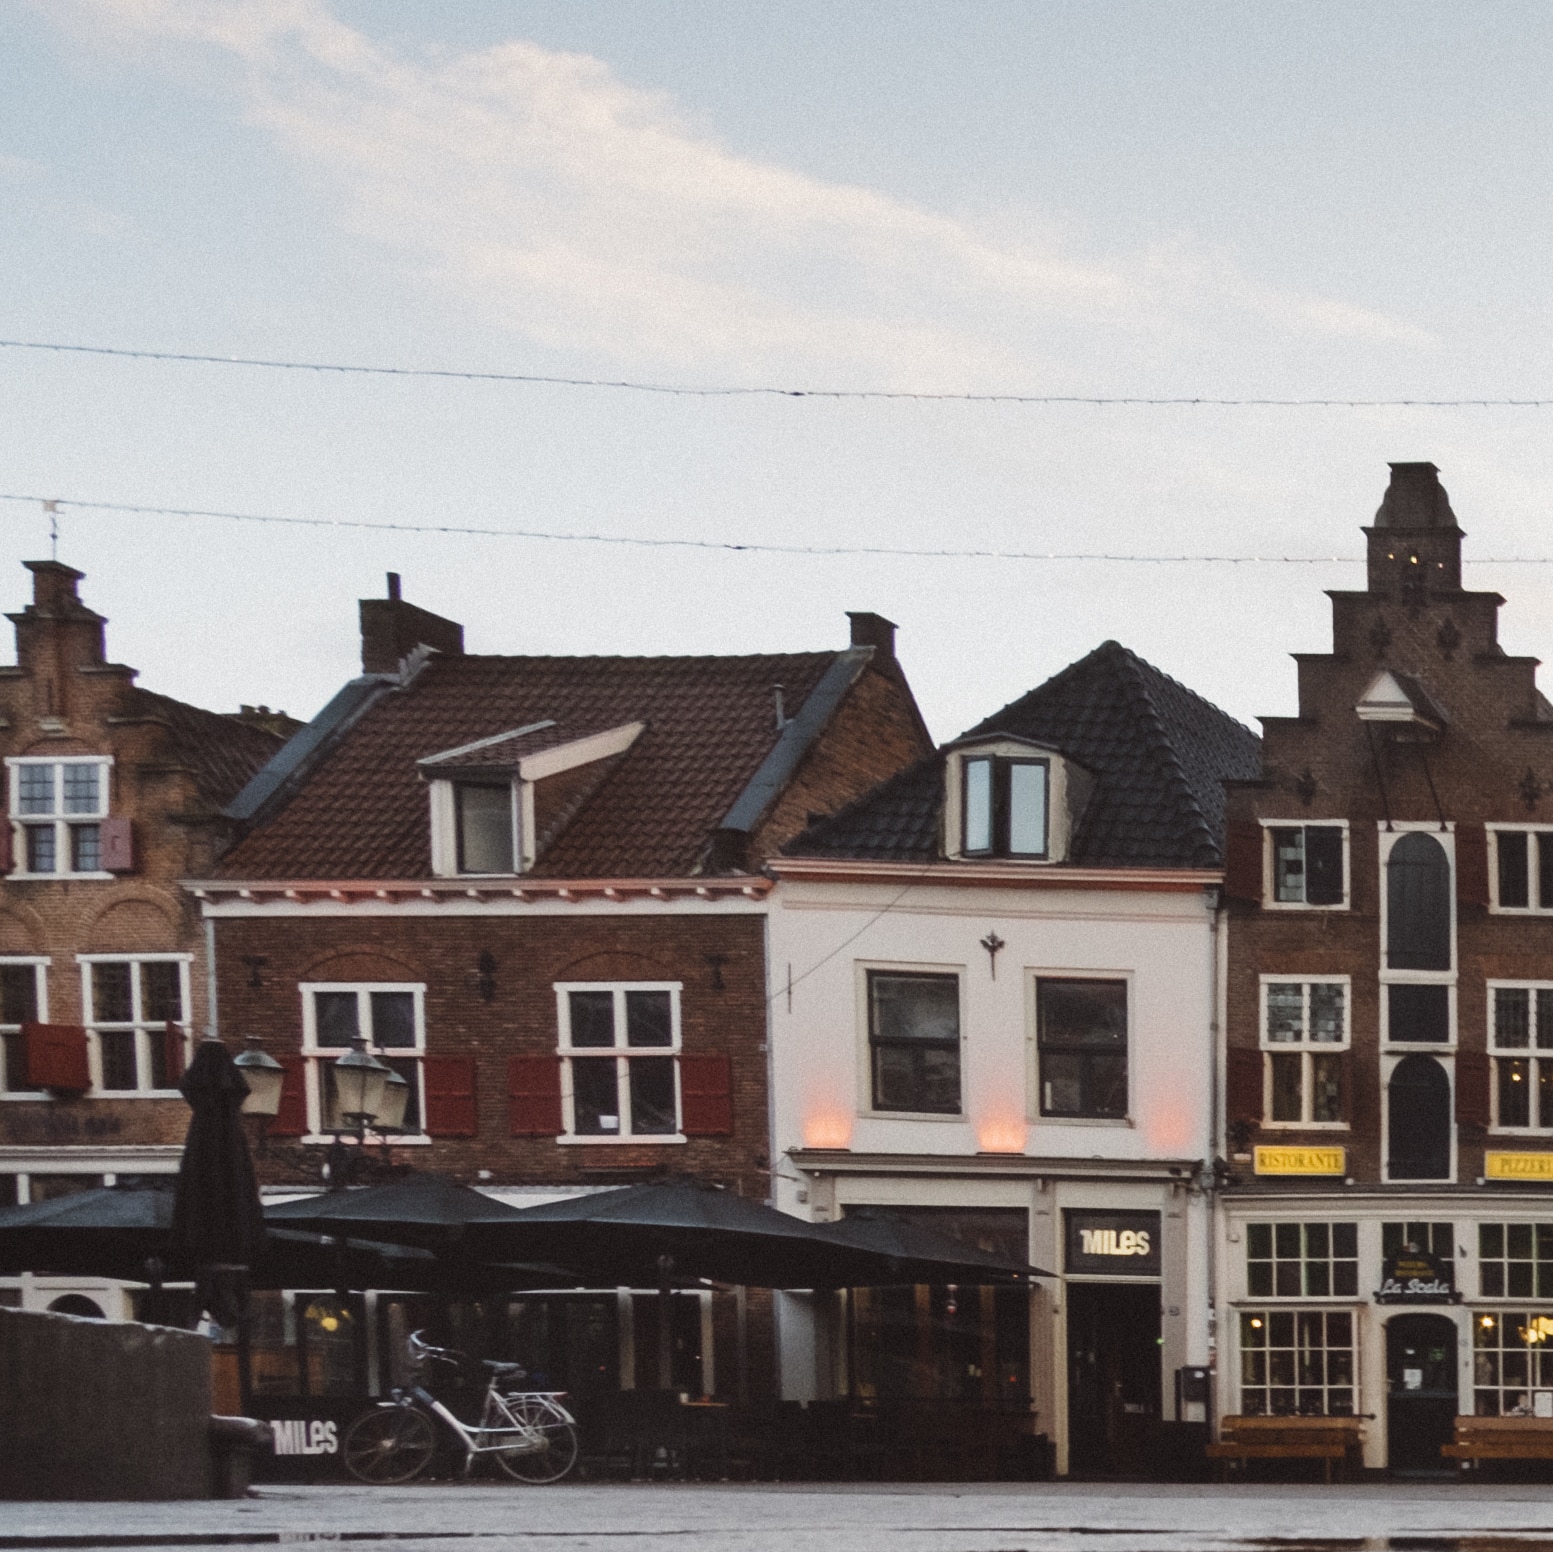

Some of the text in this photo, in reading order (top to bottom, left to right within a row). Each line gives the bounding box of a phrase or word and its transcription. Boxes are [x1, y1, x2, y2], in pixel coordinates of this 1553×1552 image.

[1260, 1153, 1342, 1169] RISTORANTE
[1381, 1278, 1451, 1295] La Scala
